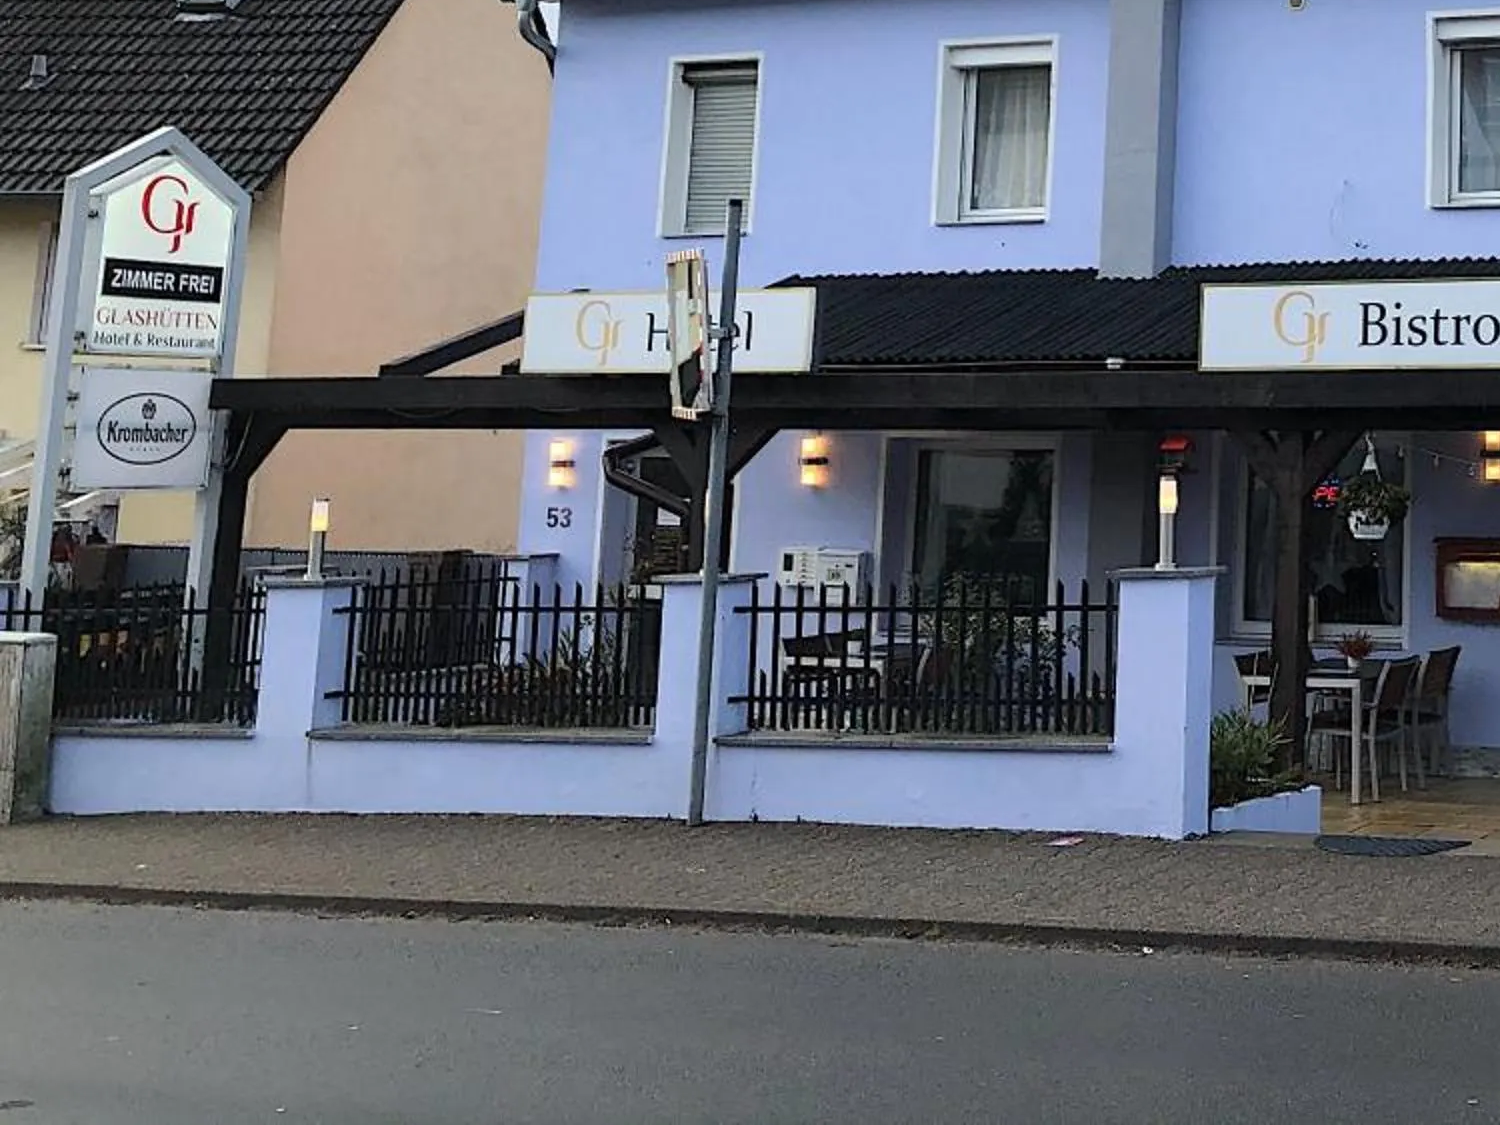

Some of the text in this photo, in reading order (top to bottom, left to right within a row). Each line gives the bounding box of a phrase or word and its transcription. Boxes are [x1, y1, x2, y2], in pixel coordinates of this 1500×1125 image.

[111, 269, 215, 294] ZIMMER FREI
[97, 306, 217, 330] GLASHÜTTEN
[1359, 301, 1500, 347] Bistro
[93, 331, 216, 350] Hotel & Restaurant
[107, 420, 188, 443] Krombacher
[547, 506, 573, 528] 53
